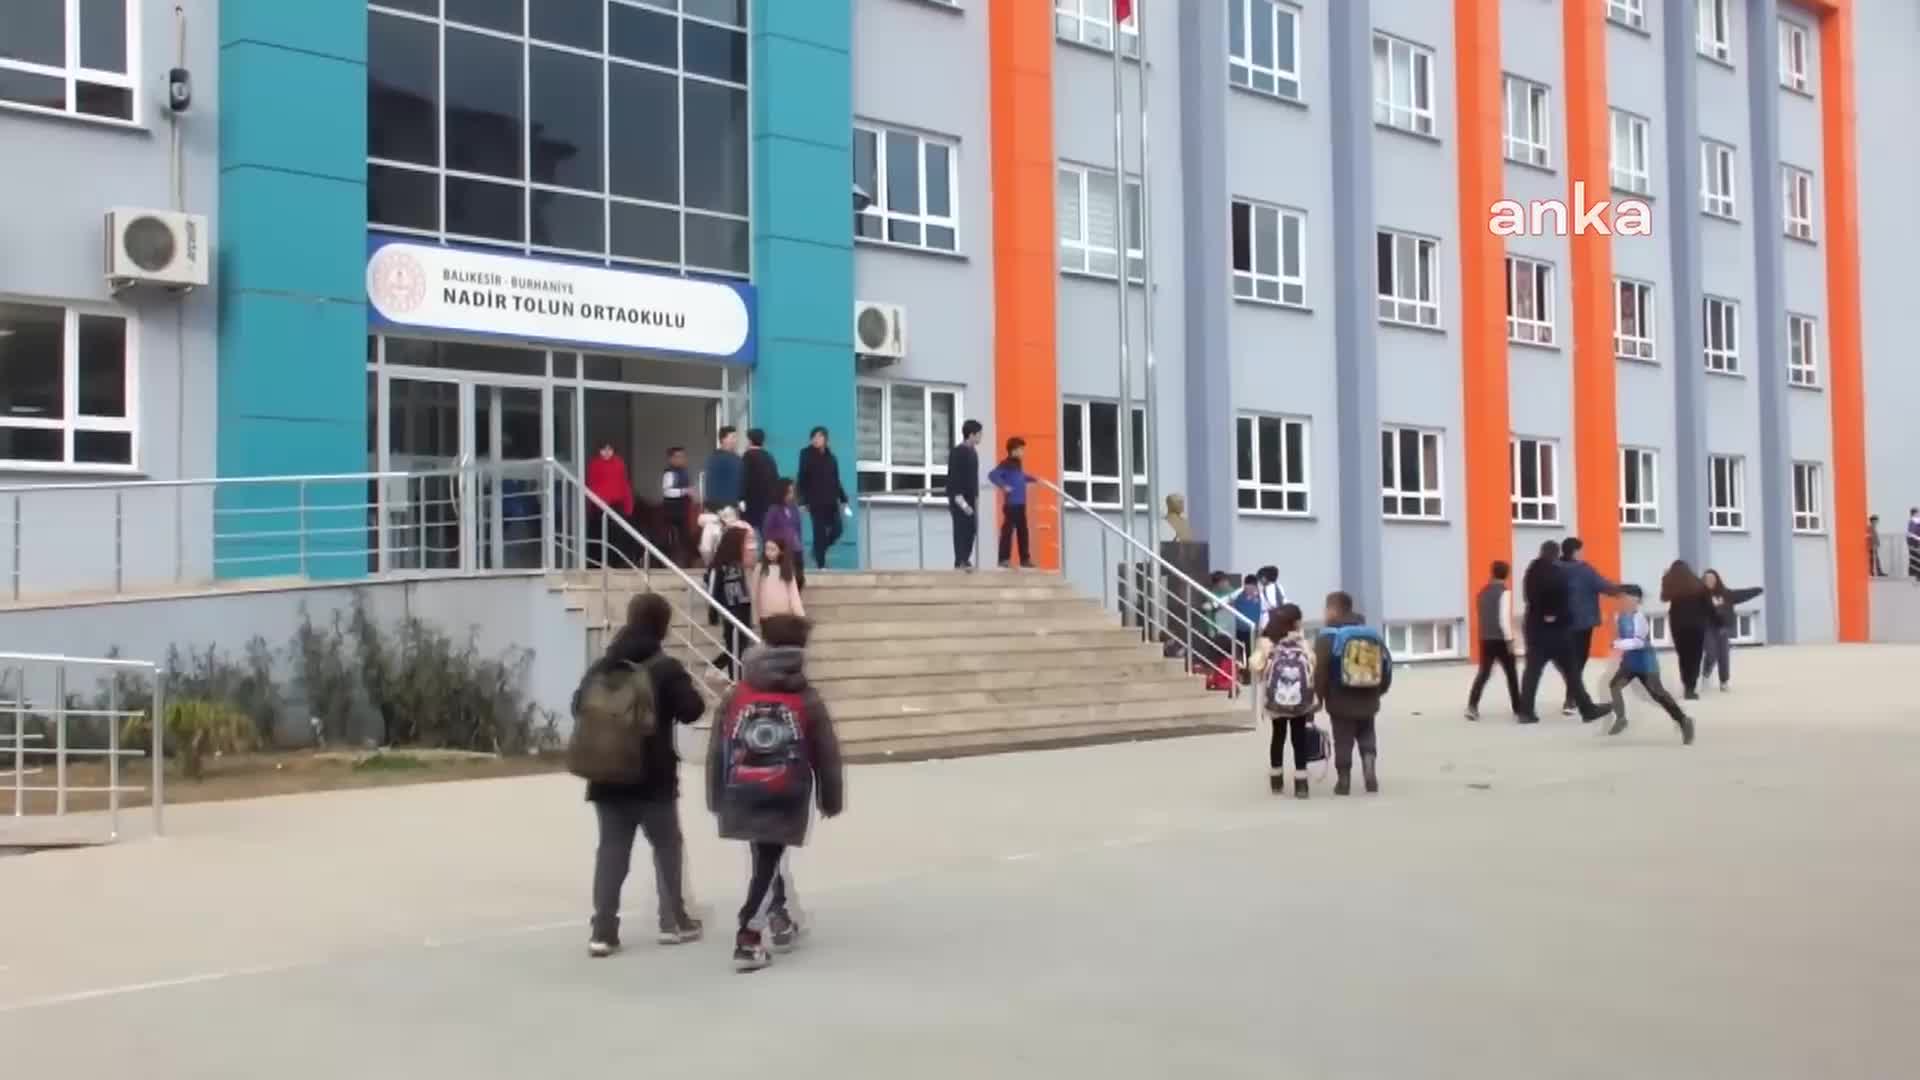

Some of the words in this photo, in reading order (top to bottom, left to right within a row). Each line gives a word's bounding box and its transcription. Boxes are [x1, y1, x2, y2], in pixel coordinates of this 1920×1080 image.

[443, 268, 502, 286] BALIKESİR
[511, 275, 574, 295] BURHANİYE
[443, 287, 507, 310] NADİR
[512, 295, 574, 317] TOLUN
[580, 303, 686, 329] ORTAOKULU
